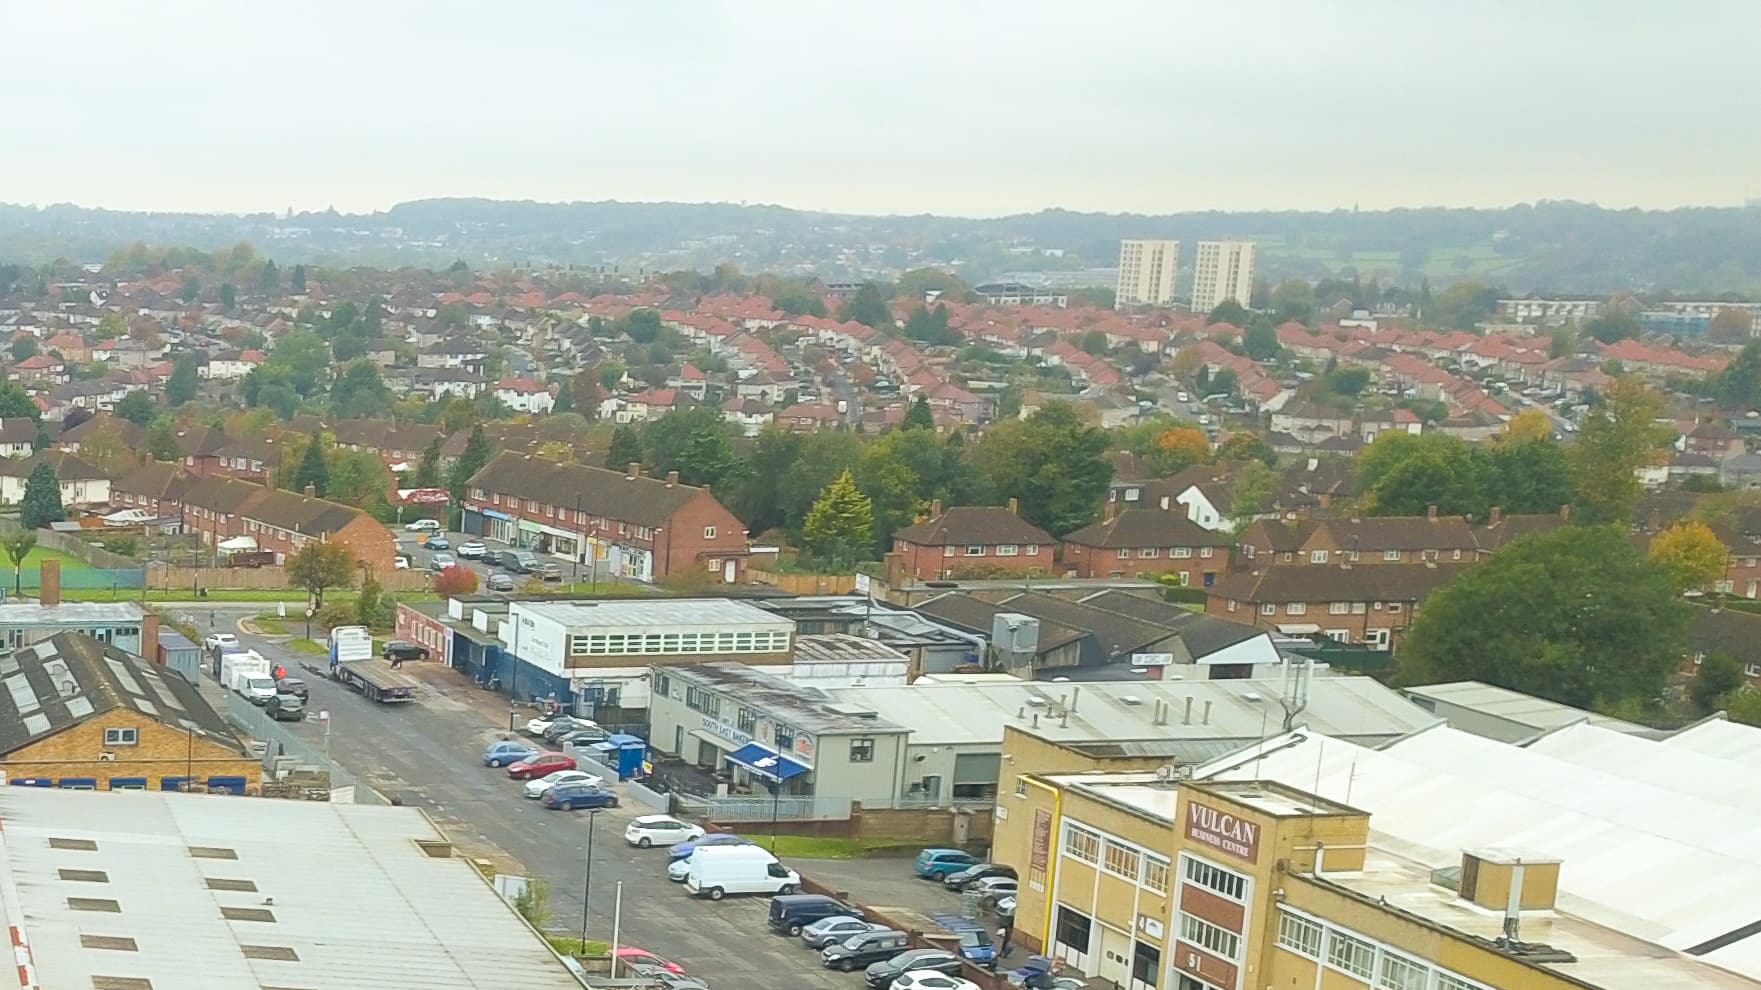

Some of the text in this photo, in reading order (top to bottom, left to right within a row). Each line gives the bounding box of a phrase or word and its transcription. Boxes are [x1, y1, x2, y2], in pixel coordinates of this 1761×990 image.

[1191, 802, 1256, 845] VULCAN
[1191, 827, 1249, 857] BUSINESS CENTRE
[1188, 953, 1201, 973] 51
